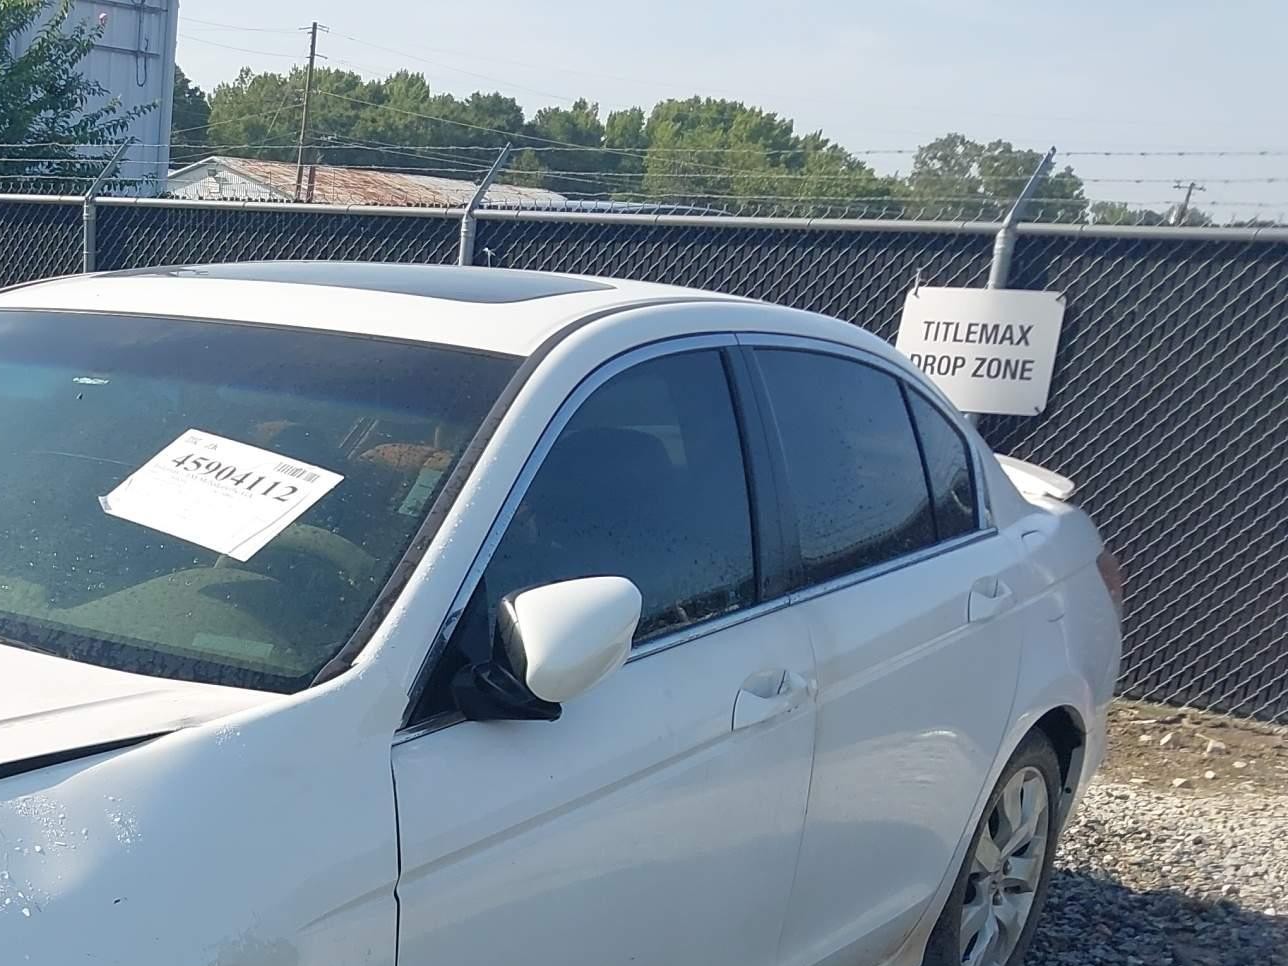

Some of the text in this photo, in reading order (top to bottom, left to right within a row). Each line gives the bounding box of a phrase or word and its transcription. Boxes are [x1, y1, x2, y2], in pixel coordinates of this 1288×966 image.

[923, 320, 1034, 346] TITLEMAX
[971, 357, 1035, 380] ZONE
[171, 452, 298, 502] 45904112
